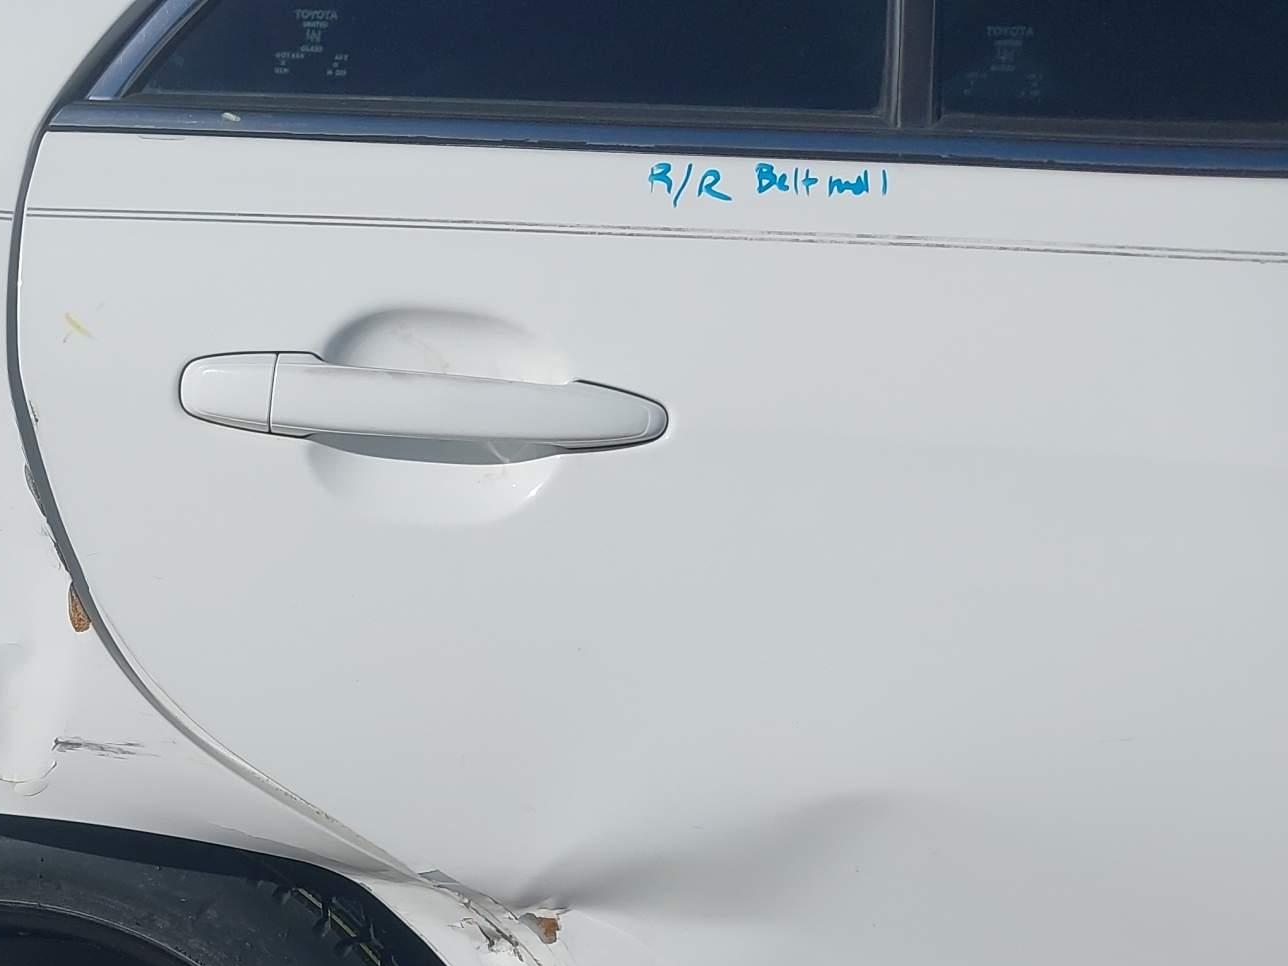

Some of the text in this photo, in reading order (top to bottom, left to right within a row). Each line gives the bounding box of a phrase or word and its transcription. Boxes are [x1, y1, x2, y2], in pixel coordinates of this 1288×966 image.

[294, 8, 338, 20] TOYOTA
[648, 163, 732, 208] R/R
[756, 163, 818, 196] Belt
